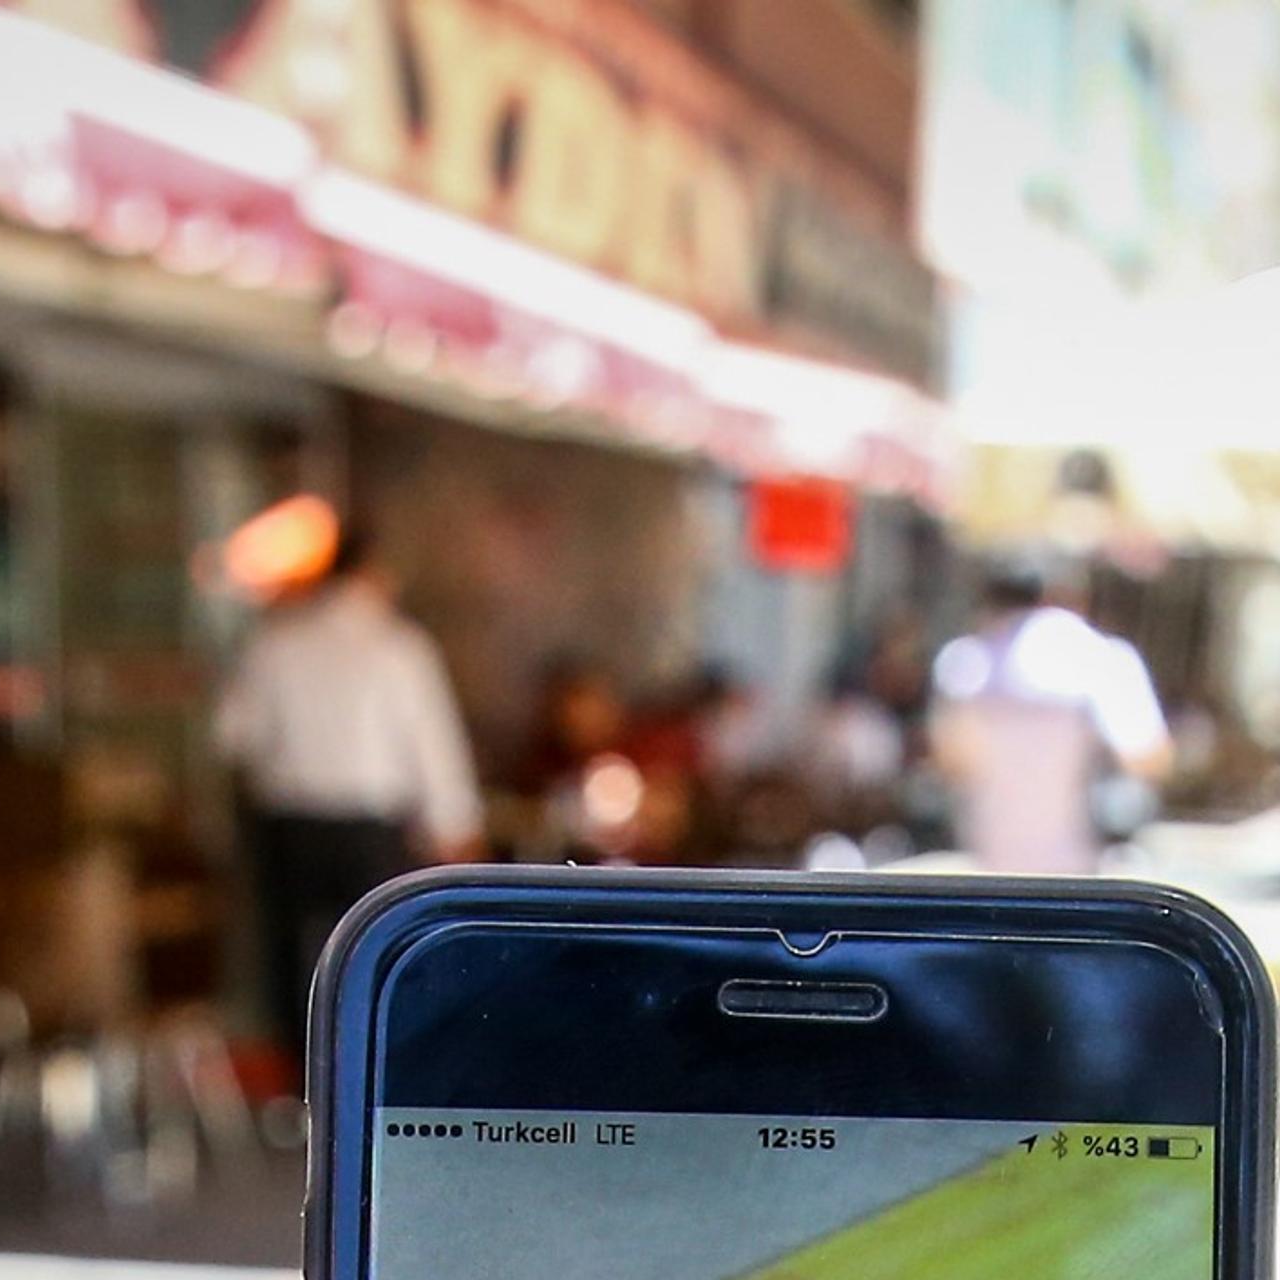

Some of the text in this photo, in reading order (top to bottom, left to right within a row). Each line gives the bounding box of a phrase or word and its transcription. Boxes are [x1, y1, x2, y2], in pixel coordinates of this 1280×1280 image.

[472, 1121, 1139, 1158] Turkcell LTE 12:55 %43
